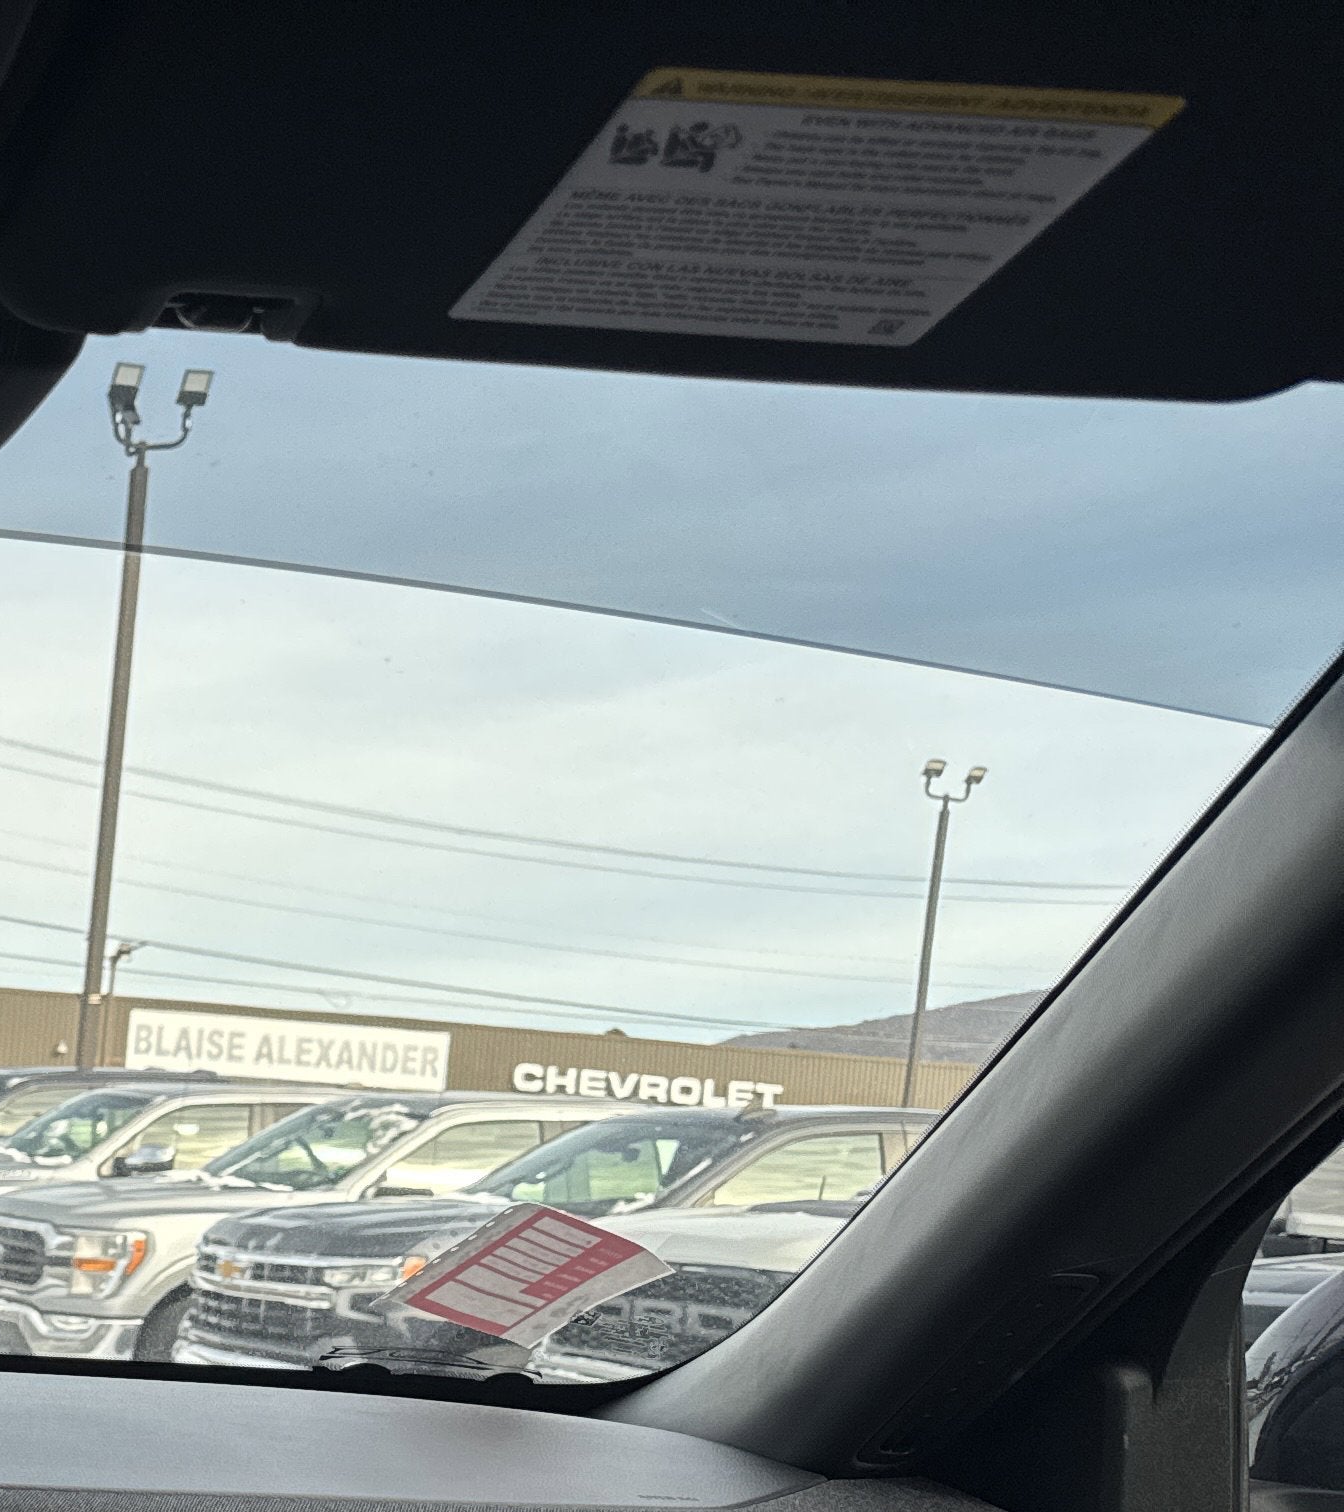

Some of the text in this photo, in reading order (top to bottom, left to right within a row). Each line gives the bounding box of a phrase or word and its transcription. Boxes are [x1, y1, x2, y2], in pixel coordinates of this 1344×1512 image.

[133, 1023, 439, 1079] BLAISE ALEXANDER
[513, 1062, 784, 1109] CHEVROLET
